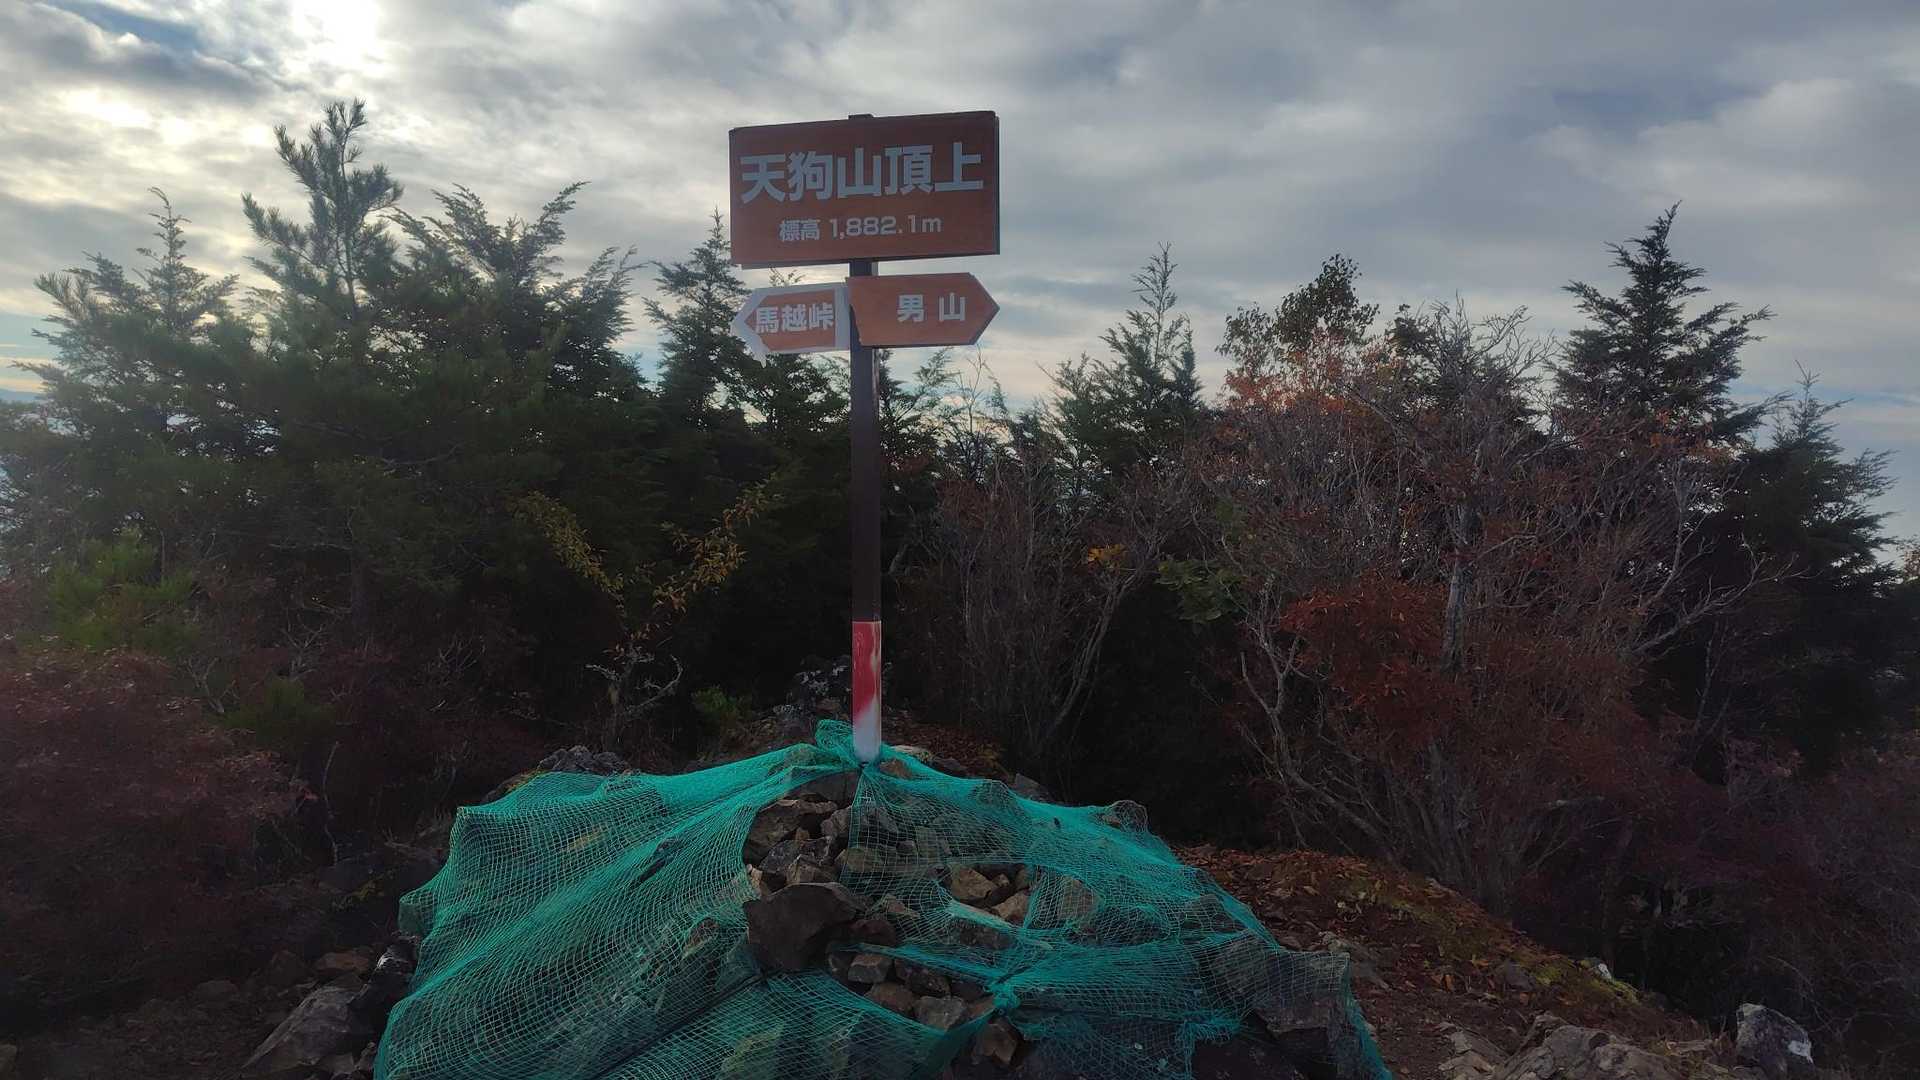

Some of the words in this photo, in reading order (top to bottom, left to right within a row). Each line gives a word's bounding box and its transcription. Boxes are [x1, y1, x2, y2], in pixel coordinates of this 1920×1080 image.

[740, 142, 984, 203] 天狗山頂上
[779, 218, 821, 241] 標高
[829, 214, 942, 240] 1,882.1m
[755, 303, 835, 333] 馬越峠
[897, 293, 967, 322] 男山
